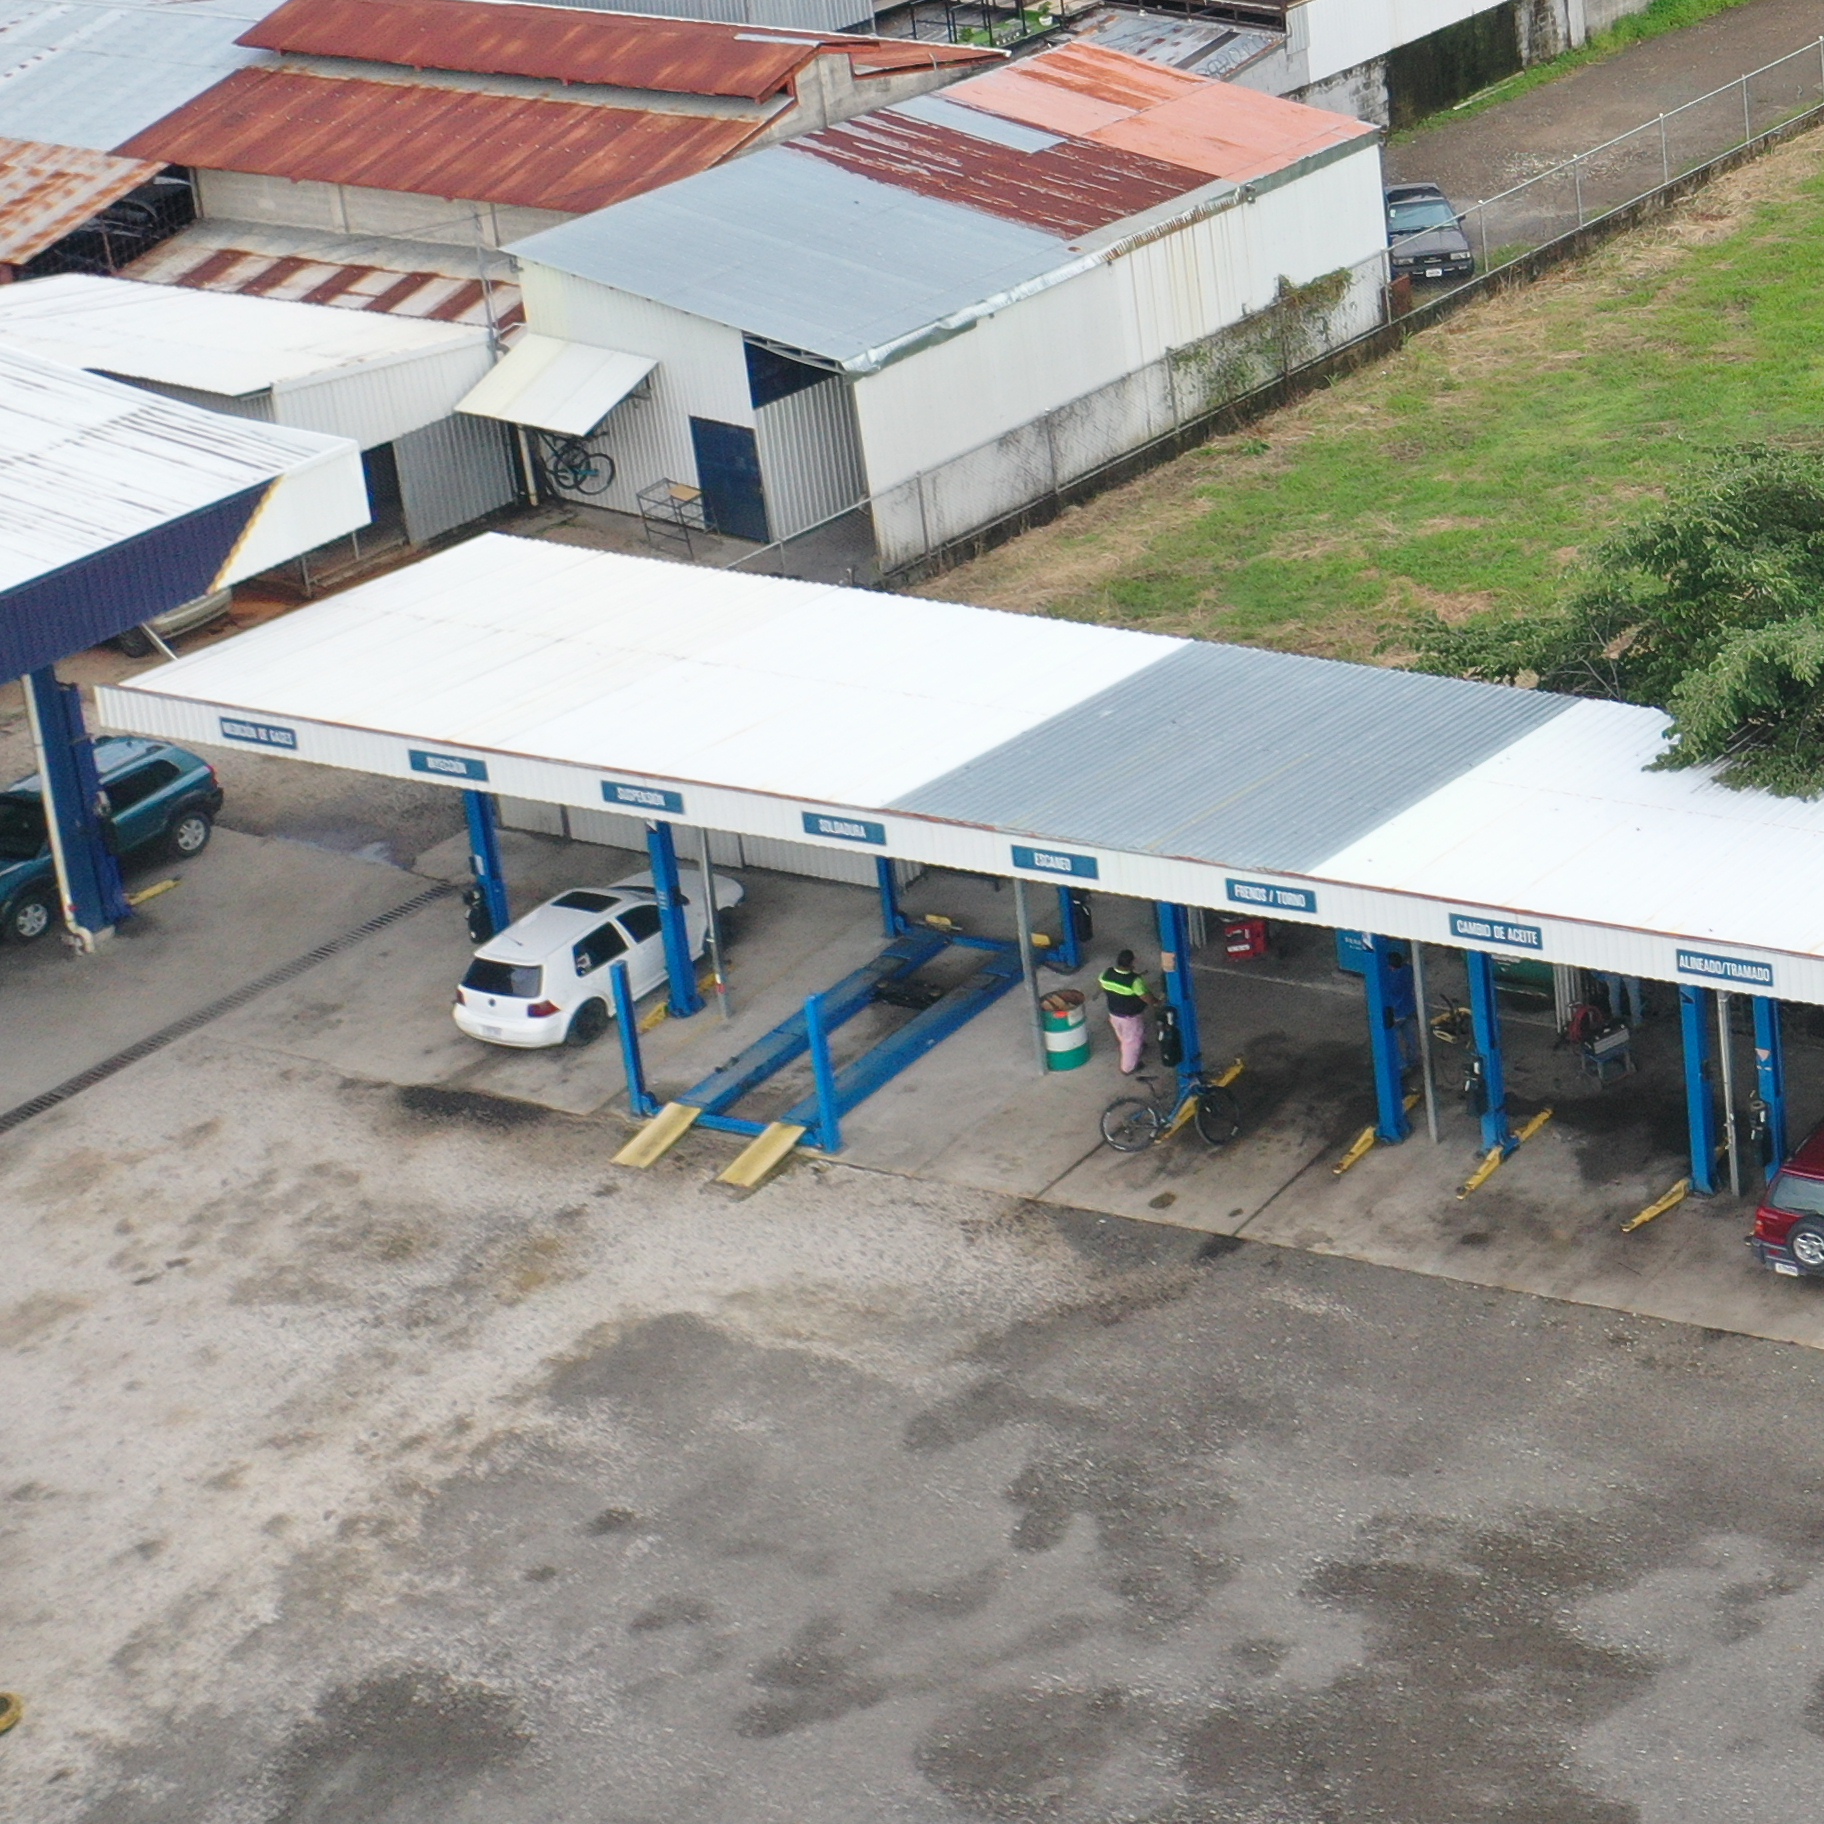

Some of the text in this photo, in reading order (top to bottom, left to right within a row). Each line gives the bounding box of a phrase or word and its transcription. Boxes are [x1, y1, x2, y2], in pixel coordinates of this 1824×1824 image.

[1456, 919, 1538, 946] CAMBIO DE ACEITE
